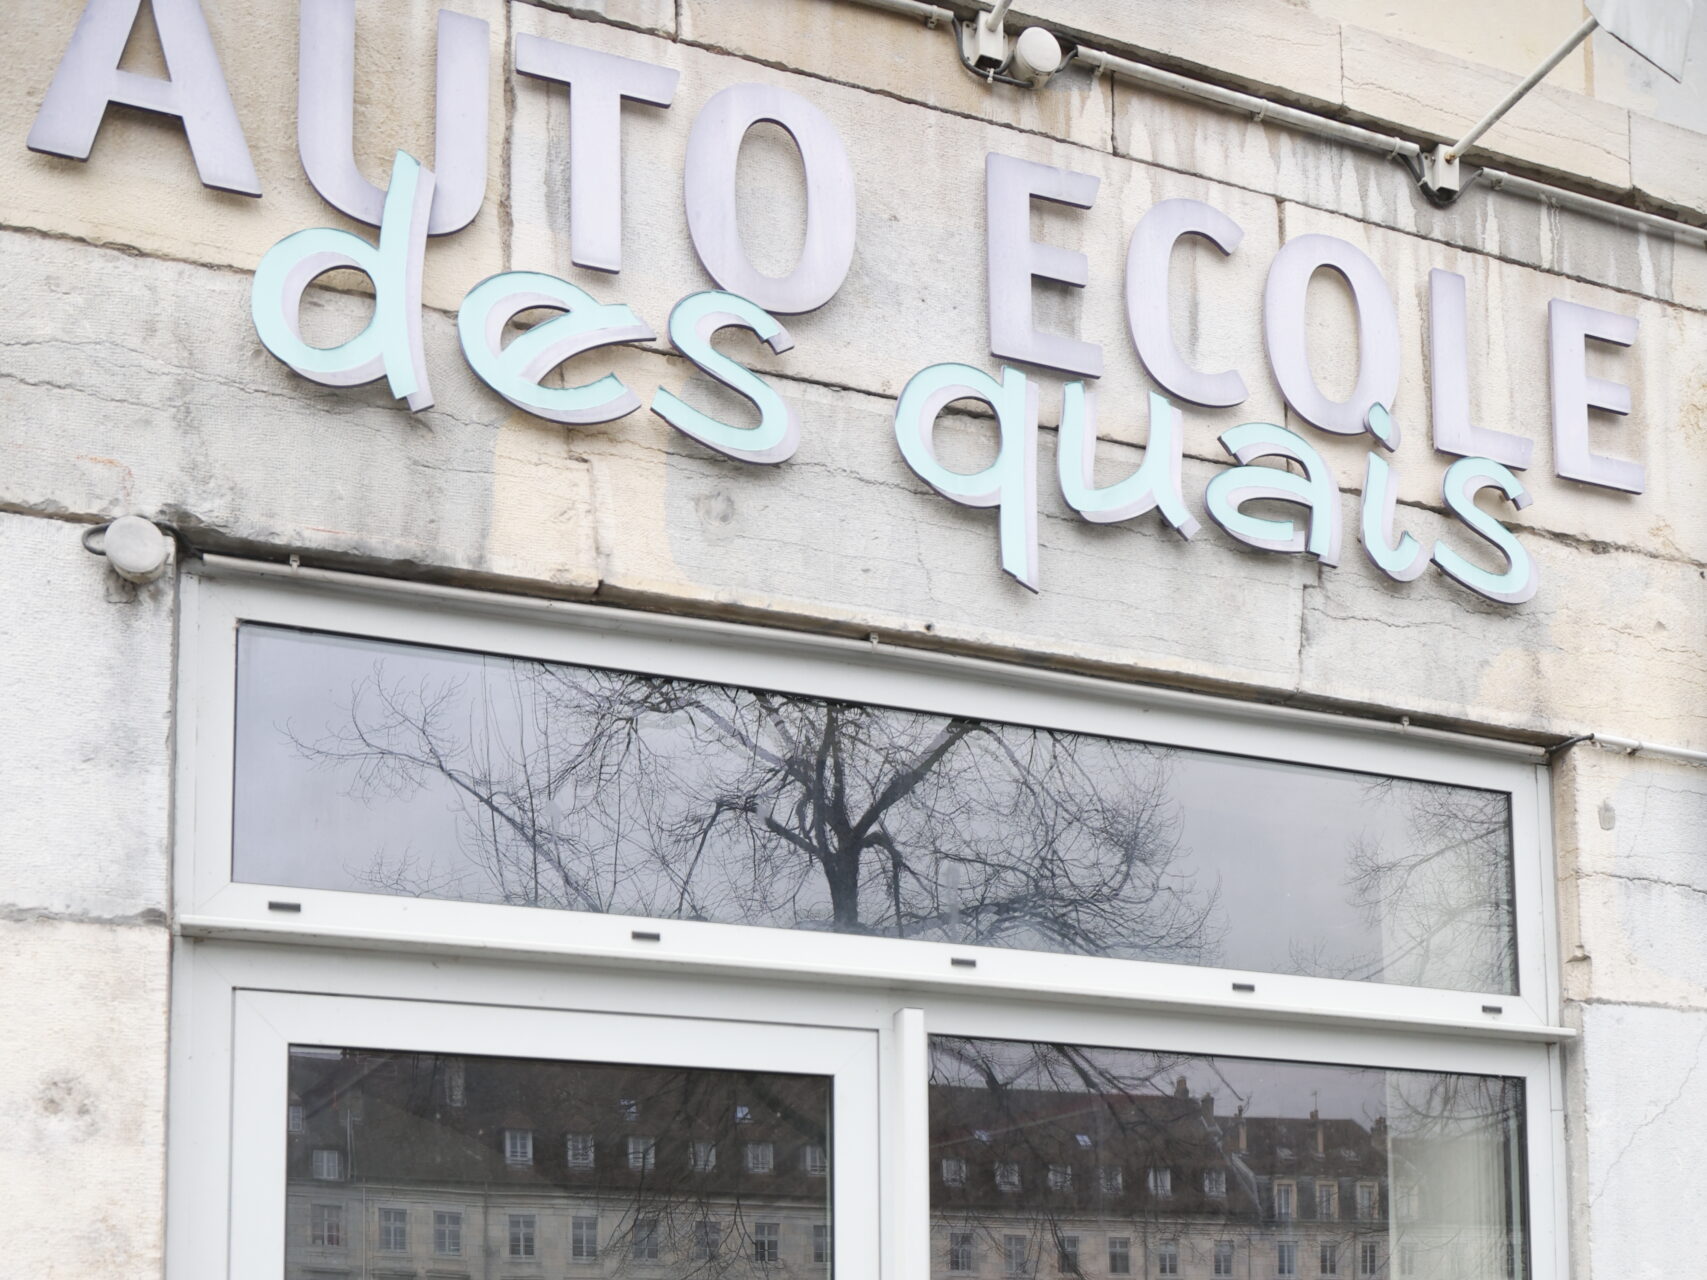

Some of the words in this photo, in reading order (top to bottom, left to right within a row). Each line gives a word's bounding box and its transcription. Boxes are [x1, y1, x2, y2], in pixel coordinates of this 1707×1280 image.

[26, 0, 857, 314] AUTO
[985, 151, 1646, 495] ECOLE
[252, 149, 802, 466] des
[894, 362, 1539, 605] quais
